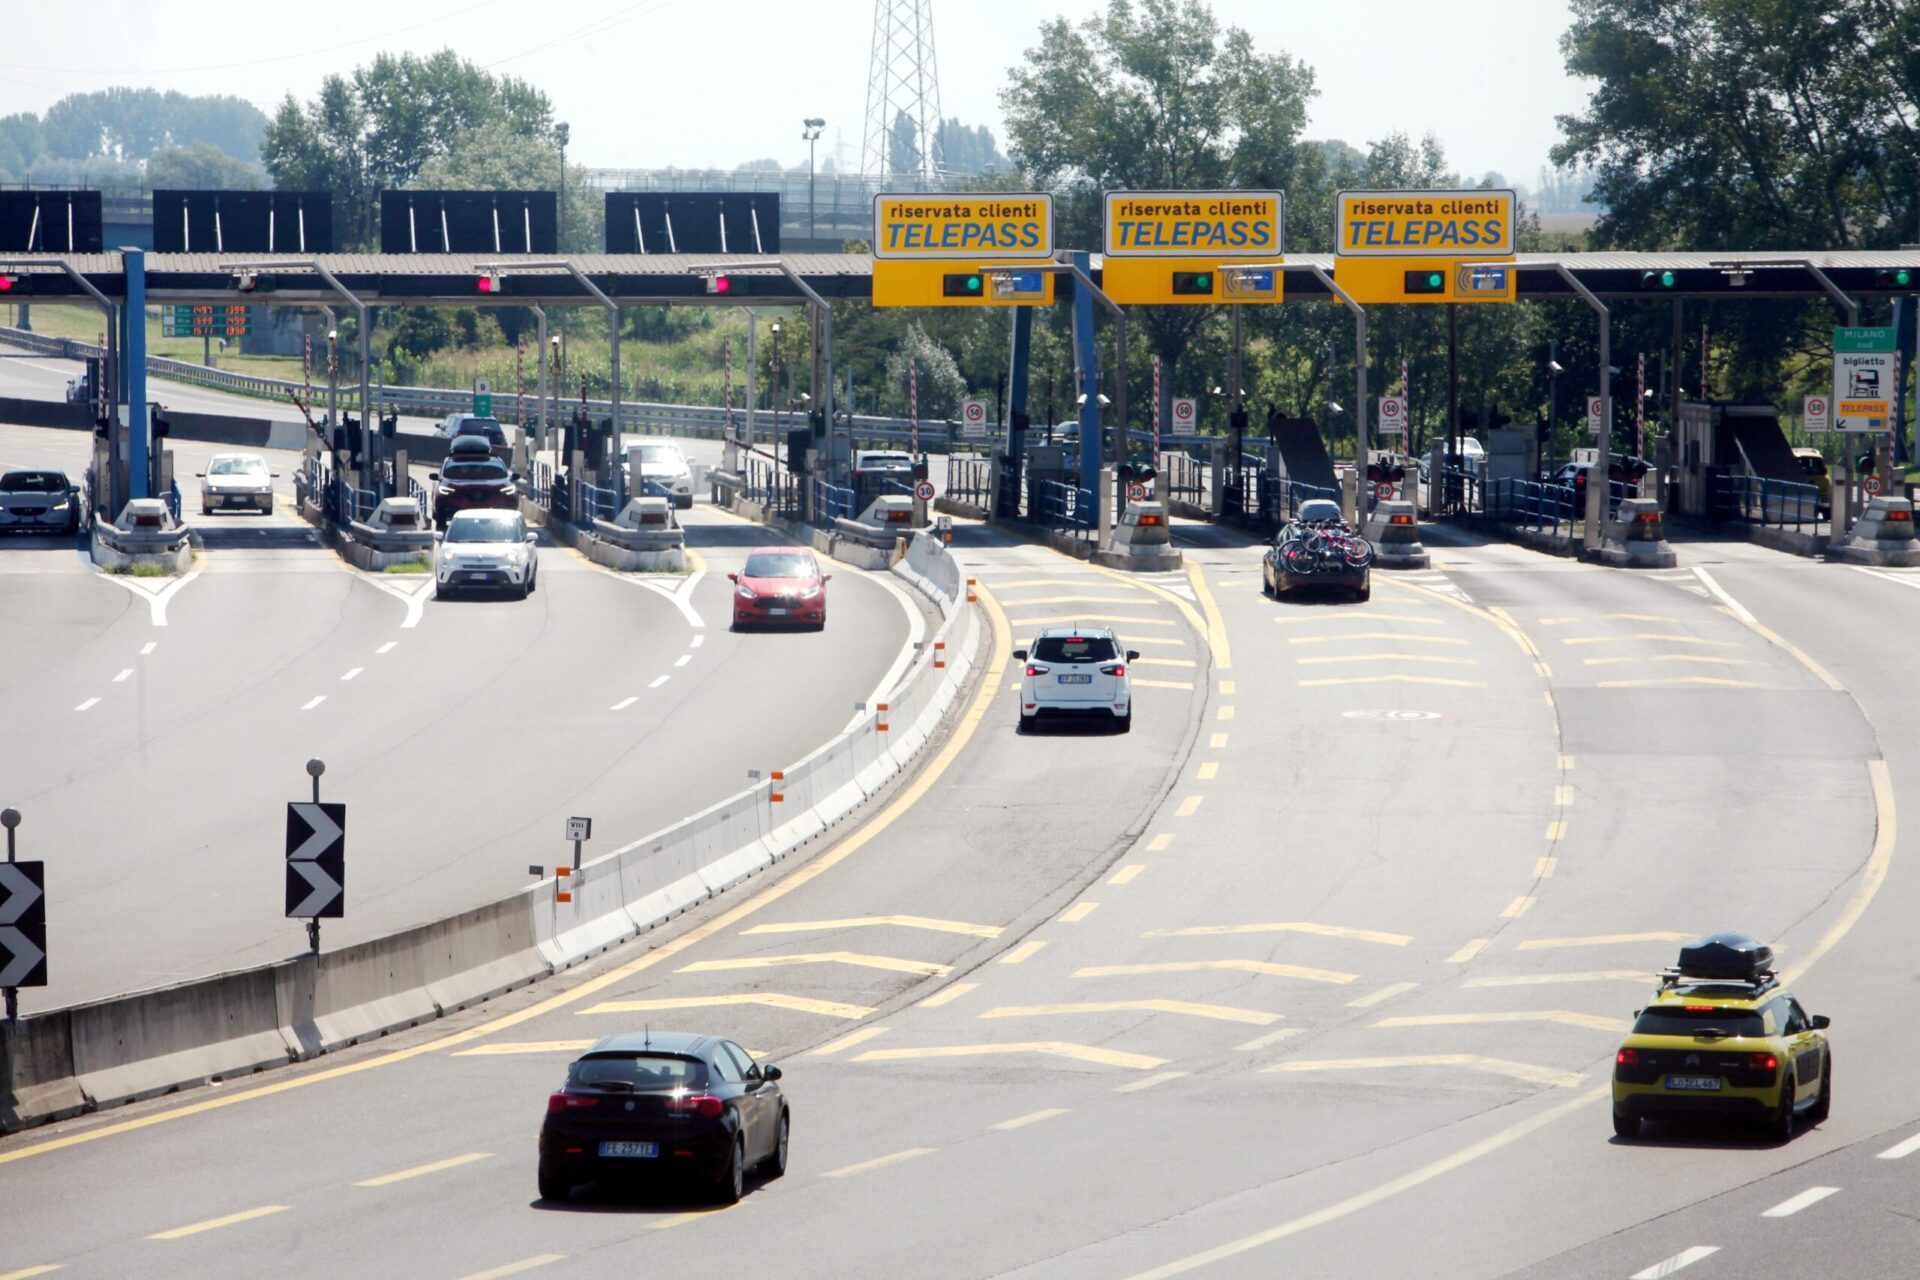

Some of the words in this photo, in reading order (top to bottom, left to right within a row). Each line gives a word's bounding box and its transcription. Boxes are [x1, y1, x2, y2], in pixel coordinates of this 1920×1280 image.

[890, 203, 972, 218] riservata
[978, 203, 1037, 218] clienti
[1120, 201, 1201, 217] riservata
[1208, 201, 1267, 216] clienti
[1352, 200, 1434, 216] riservata
[1440, 199, 1499, 215] clienti
[887, 222, 1040, 248] TELEPASS
[1118, 220, 1271, 246] TELEPASS
[1349, 219, 1502, 246] TELEPASS
[1843, 358, 1885, 367] biglietto
[970, 408, 980, 416] 50
[1180, 406, 1190, 414] 50
[1386, 404, 1396, 413] 50
[1812, 403, 1822, 412] 50
[1841, 404, 1886, 413] TELEPASS
[920, 487, 932, 496] 30
[1131, 487, 1142, 496] 30
